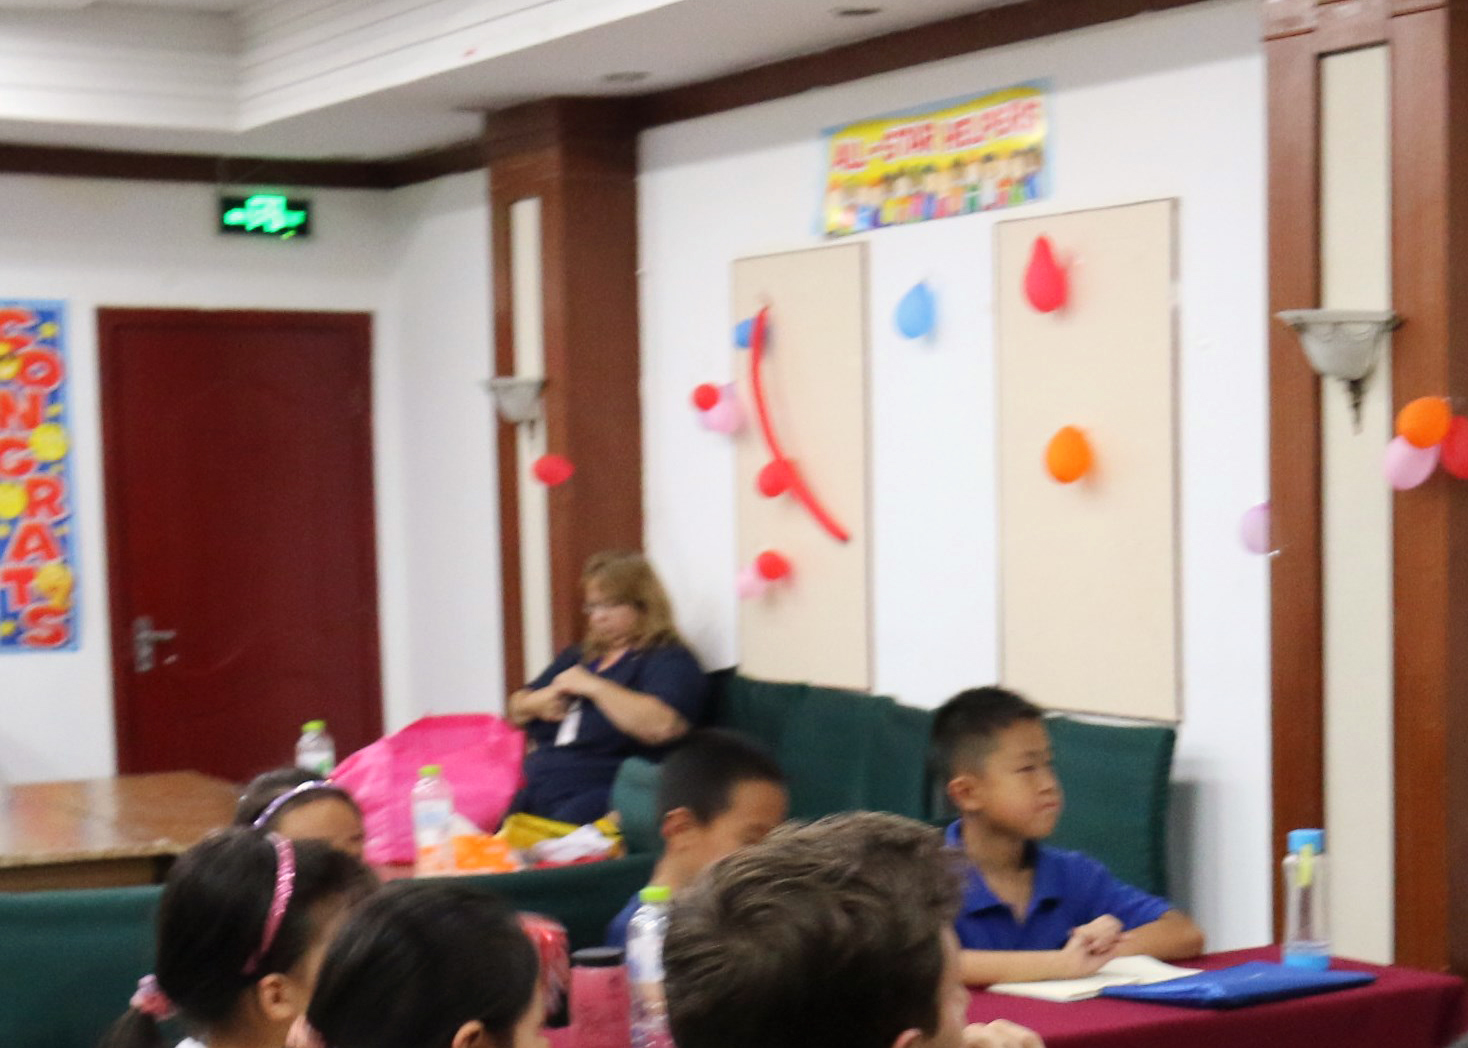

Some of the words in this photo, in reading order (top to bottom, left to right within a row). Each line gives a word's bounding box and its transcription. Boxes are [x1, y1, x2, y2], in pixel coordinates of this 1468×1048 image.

[831, 121, 933, 171] ALL-STAR
[944, 97, 1043, 149] HELPERS
[0, 309, 68, 647] CONGRATS
